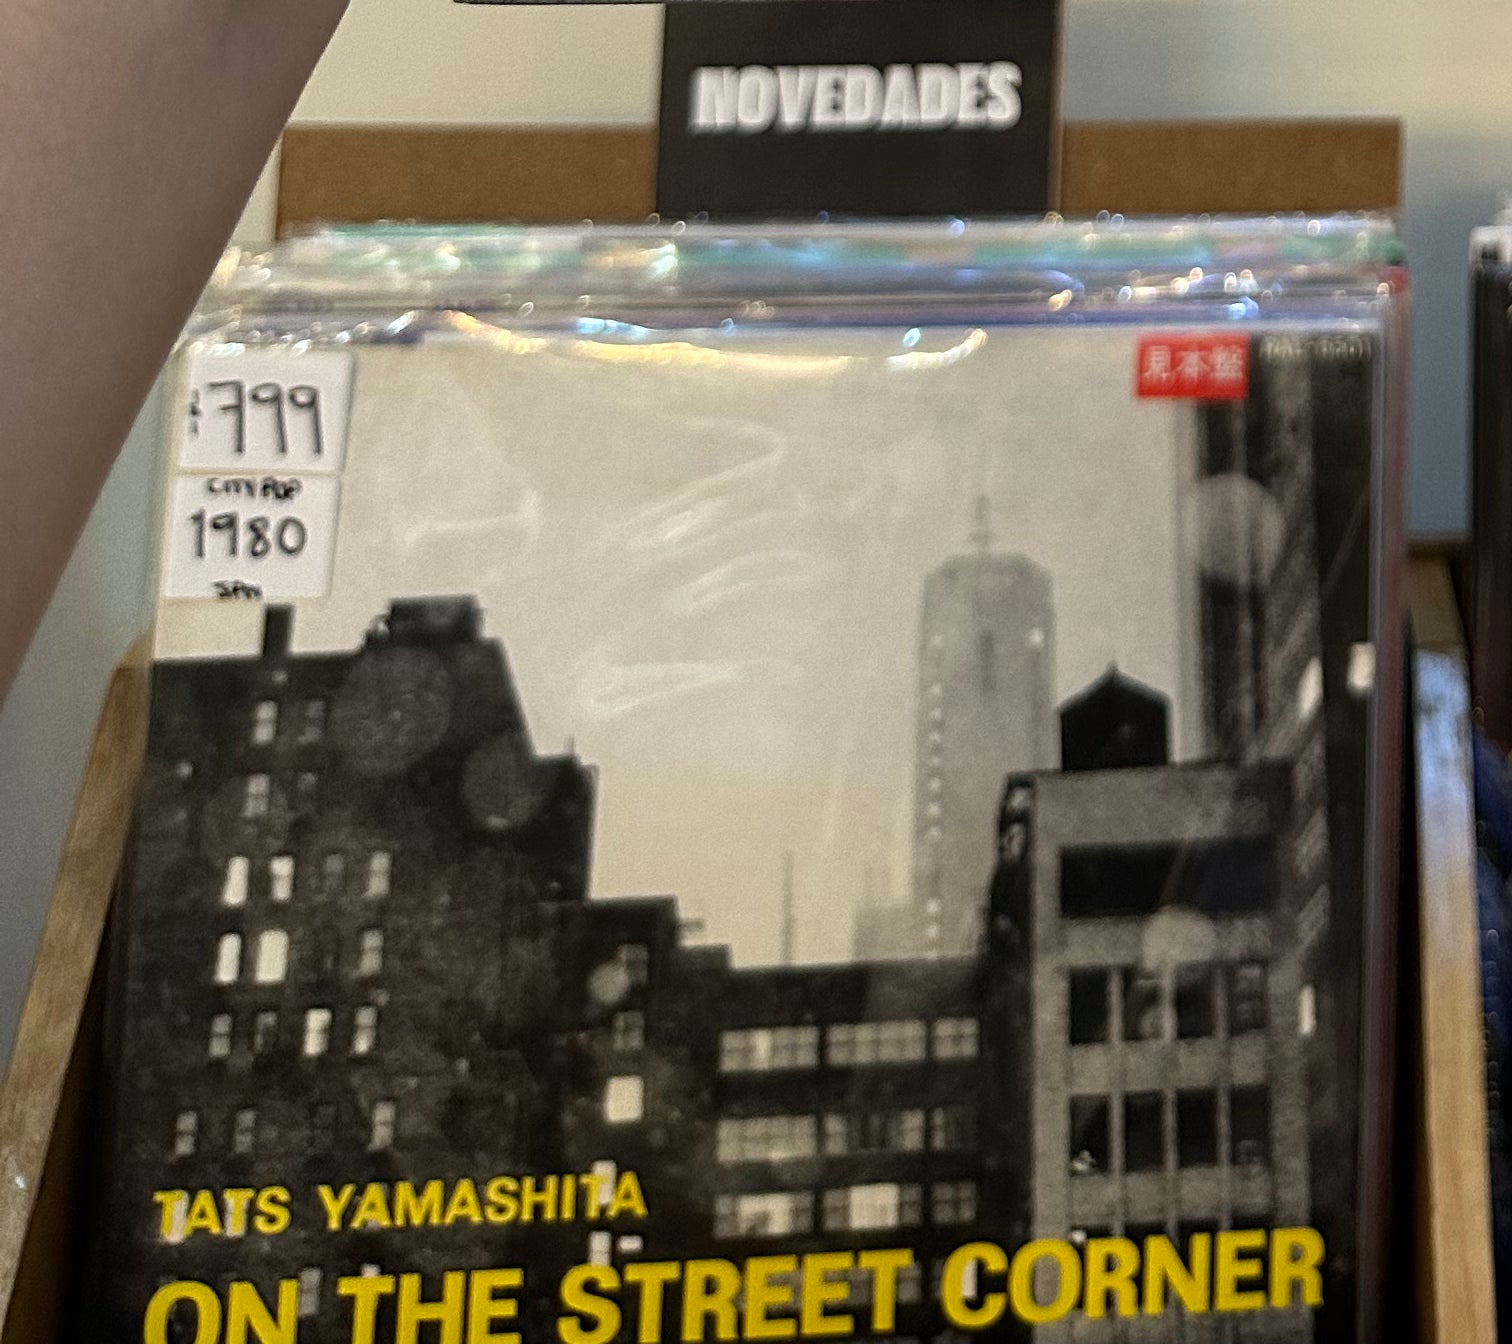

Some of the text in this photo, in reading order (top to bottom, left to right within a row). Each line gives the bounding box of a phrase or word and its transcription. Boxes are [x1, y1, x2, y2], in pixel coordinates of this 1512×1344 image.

[687, 60, 1023, 136] NOVEDADES
[190, 508, 308, 558] 1980
[153, 1173, 650, 1239] TATS YAMASHITA
[143, 1227, 1327, 1344] ON THE STREET CORNER
